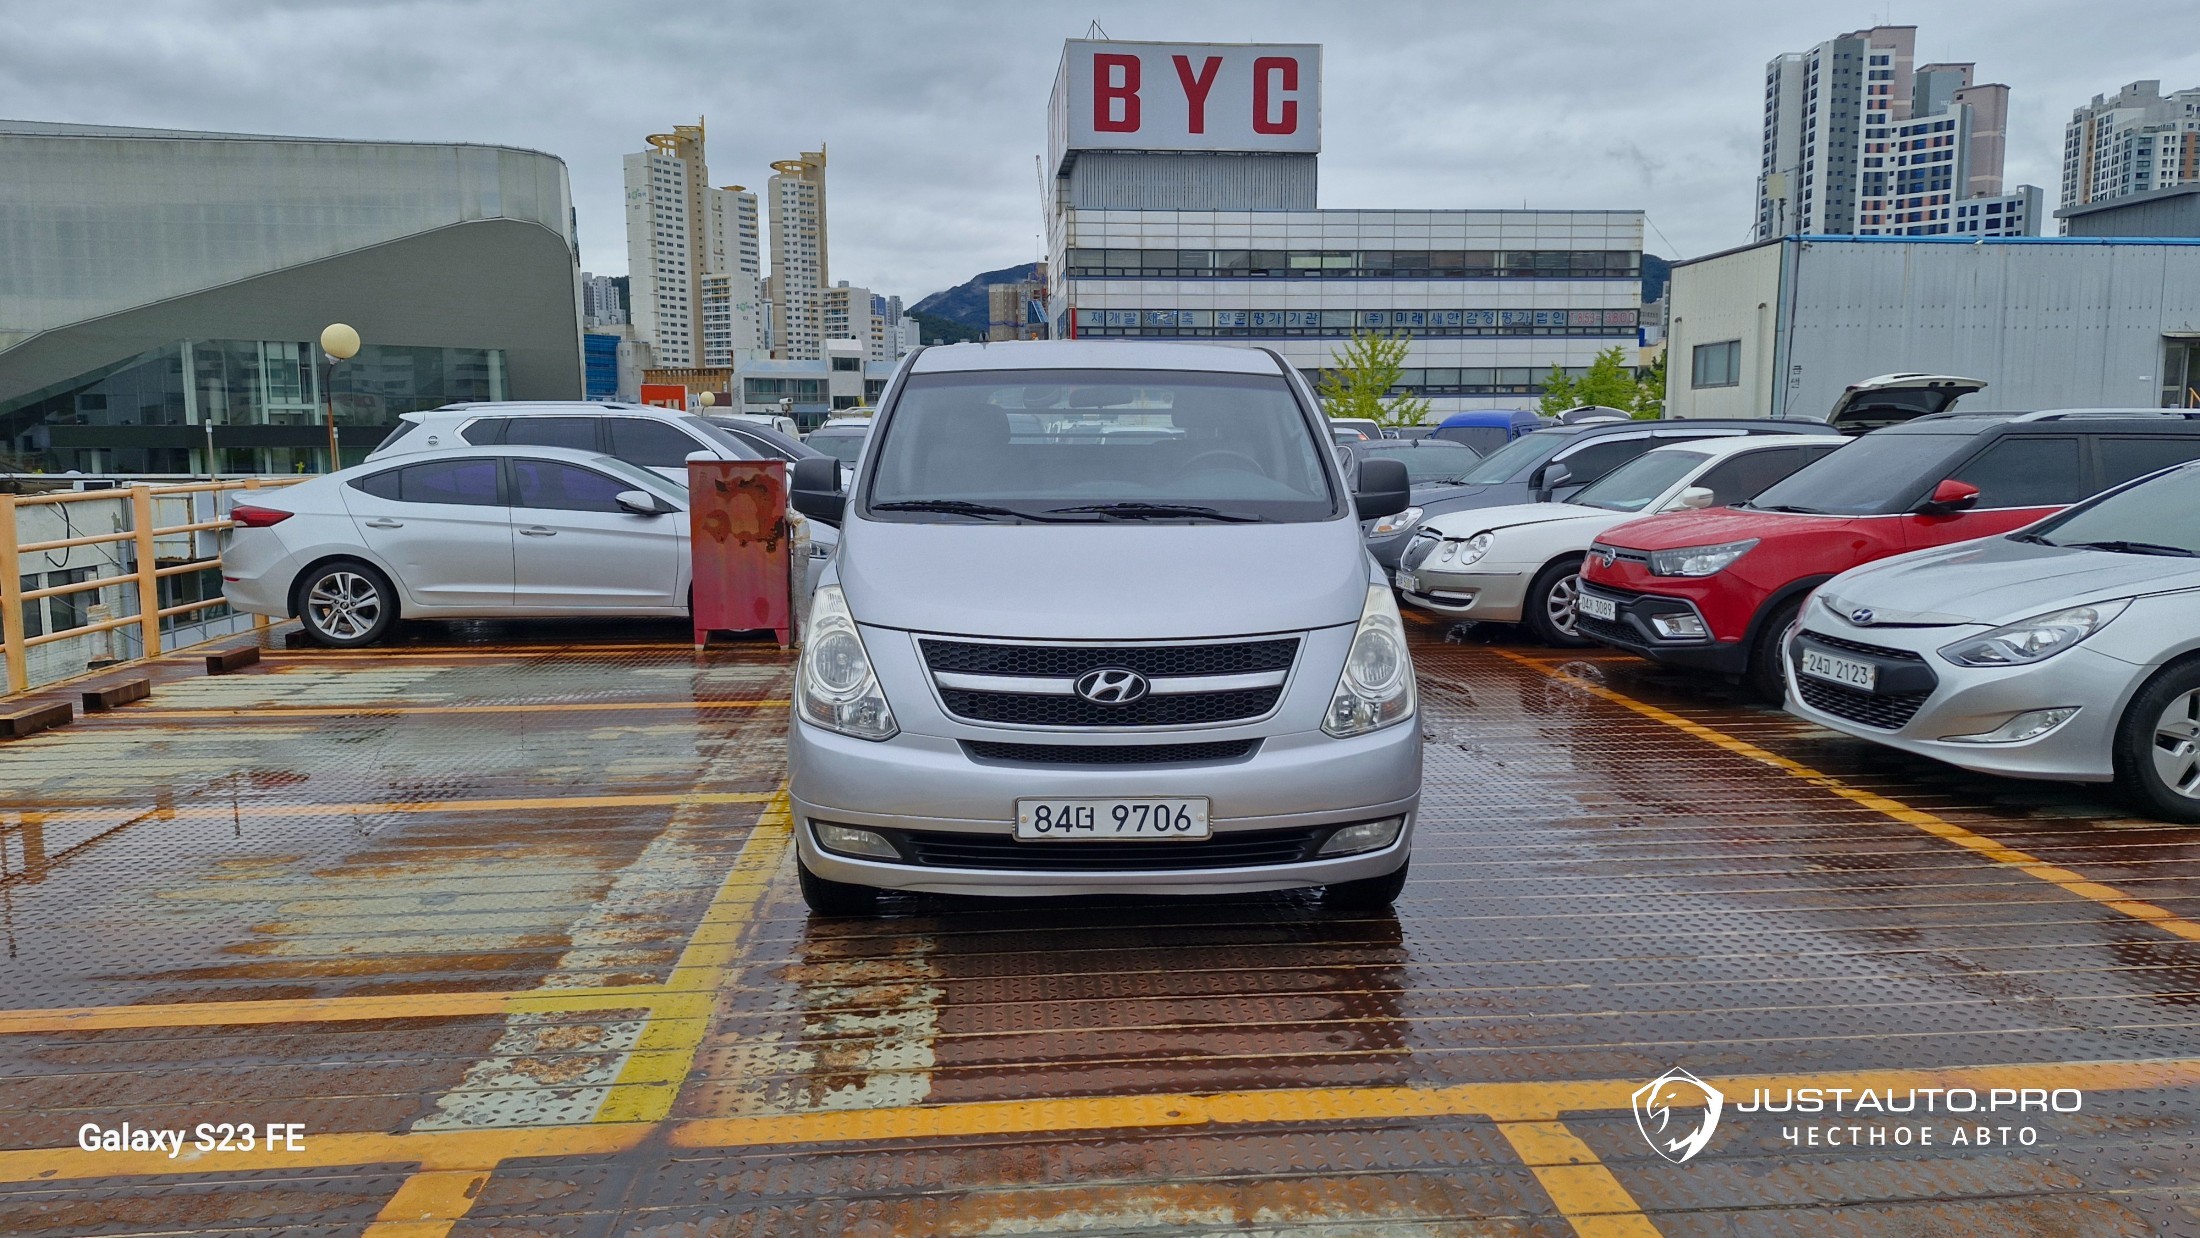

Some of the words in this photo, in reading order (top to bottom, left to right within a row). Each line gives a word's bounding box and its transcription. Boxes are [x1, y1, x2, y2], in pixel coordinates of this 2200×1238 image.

[1094, 53, 1298, 134] BYC
[1091, 311, 1137, 325] 재개발
[1364, 312, 1384, 325] (주)
[1595, 600, 1612, 616] 3089
[1836, 660, 1868, 684] 2123
[1034, 804, 1095, 833] 84더
[1111, 804, 1192, 832] 9706
